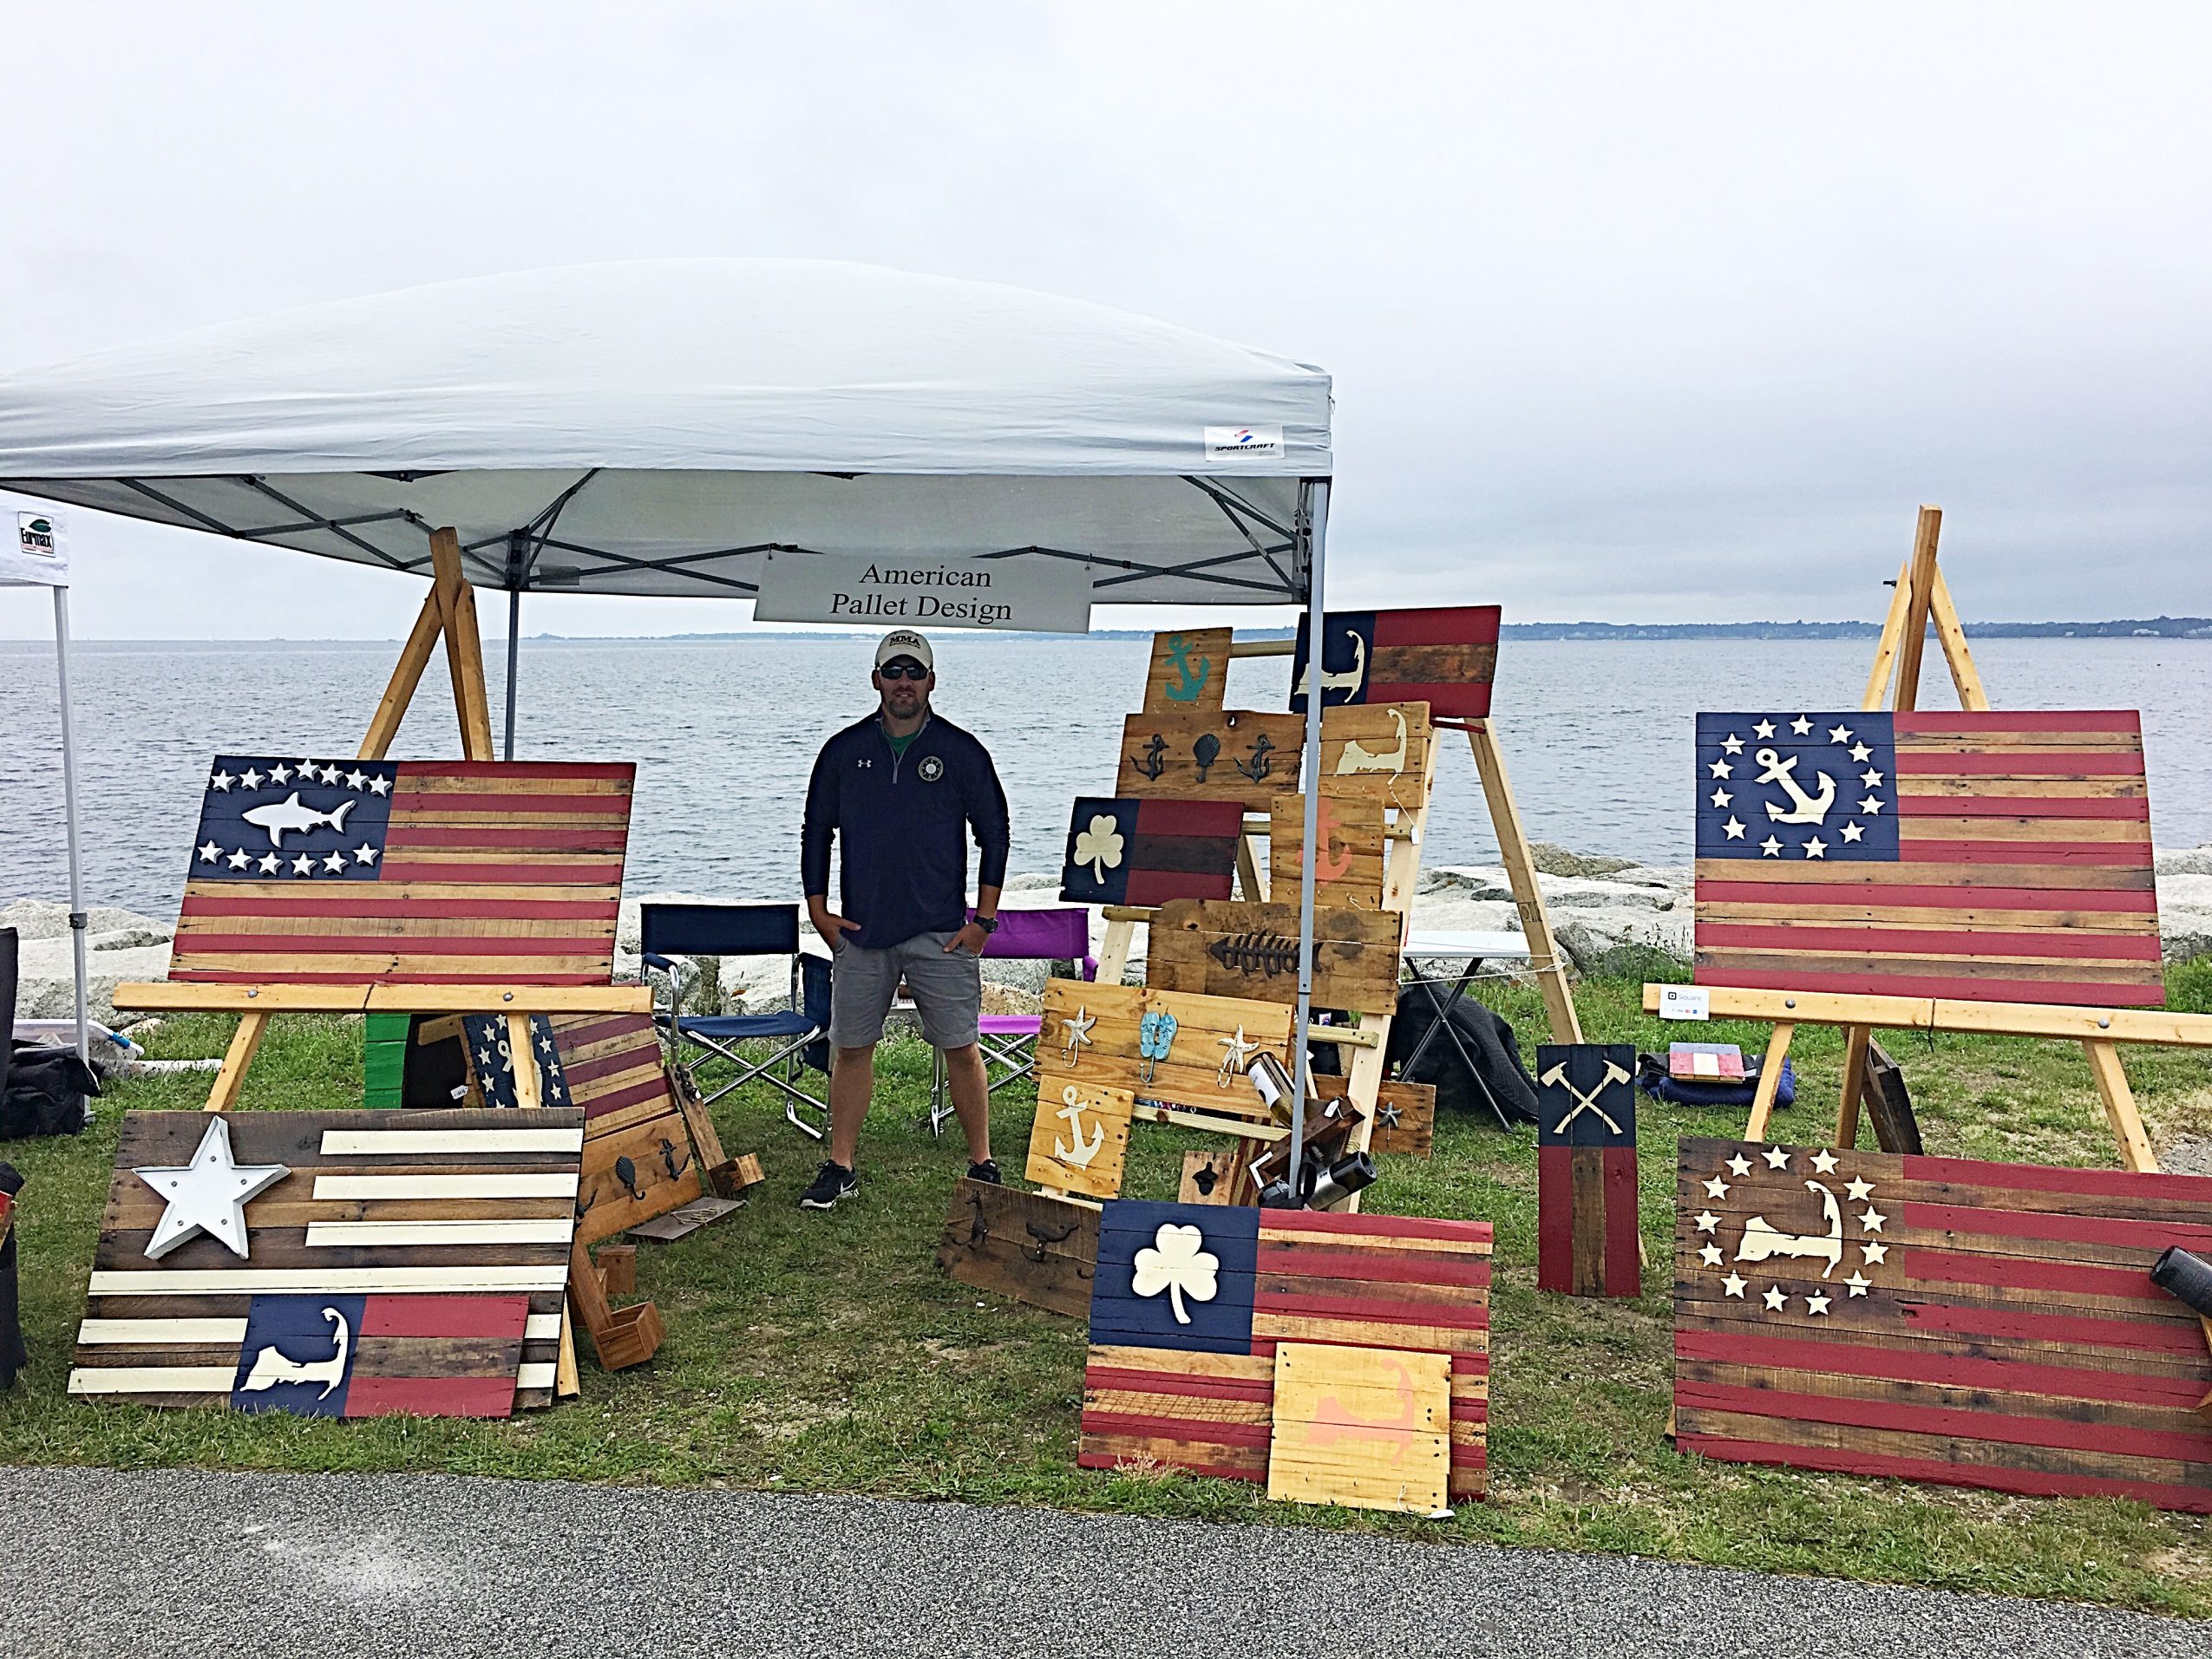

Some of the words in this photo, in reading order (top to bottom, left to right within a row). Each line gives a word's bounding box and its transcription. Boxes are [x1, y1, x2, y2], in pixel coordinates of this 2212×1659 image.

[1214, 443, 1275, 452] SPORTCRAFT
[20, 527, 52, 548] Eurmax
[859, 563, 992, 589] American
[829, 592, 909, 617] Pallet
[915, 595, 1012, 625] Design
[889, 635, 921, 647] MMA
[1678, 993, 1702, 1002] Square
